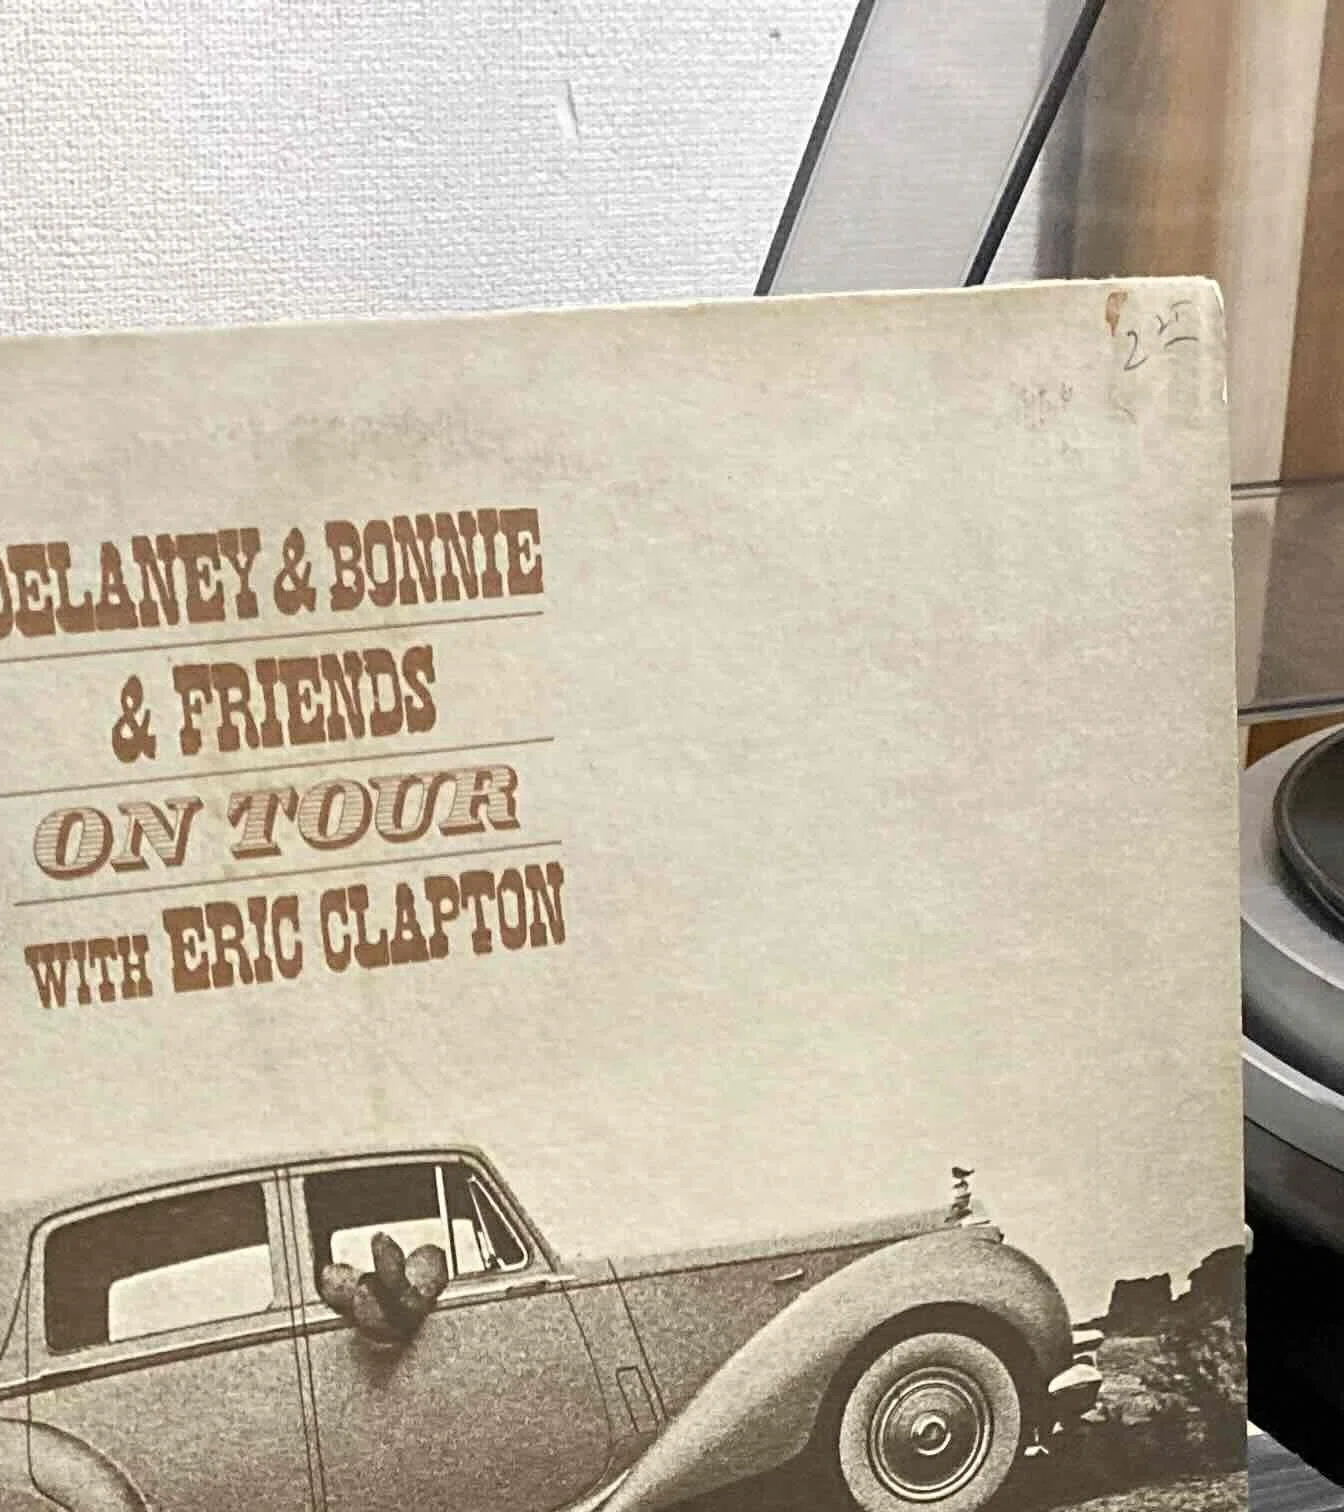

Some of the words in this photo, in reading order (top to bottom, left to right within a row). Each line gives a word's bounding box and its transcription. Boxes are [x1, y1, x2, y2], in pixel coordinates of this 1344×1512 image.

[272, 527, 318, 616] &
[323, 507, 545, 612] BONNIE
[111, 674, 157, 764] &
[172, 644, 438, 756] FRIENDS
[31, 798, 205, 881] ON
[227, 763, 521, 860] TOUR
[24, 934, 154, 1009] WITH
[162, 895, 304, 993] ERIC
[319, 861, 567, 974] CLAPTON
